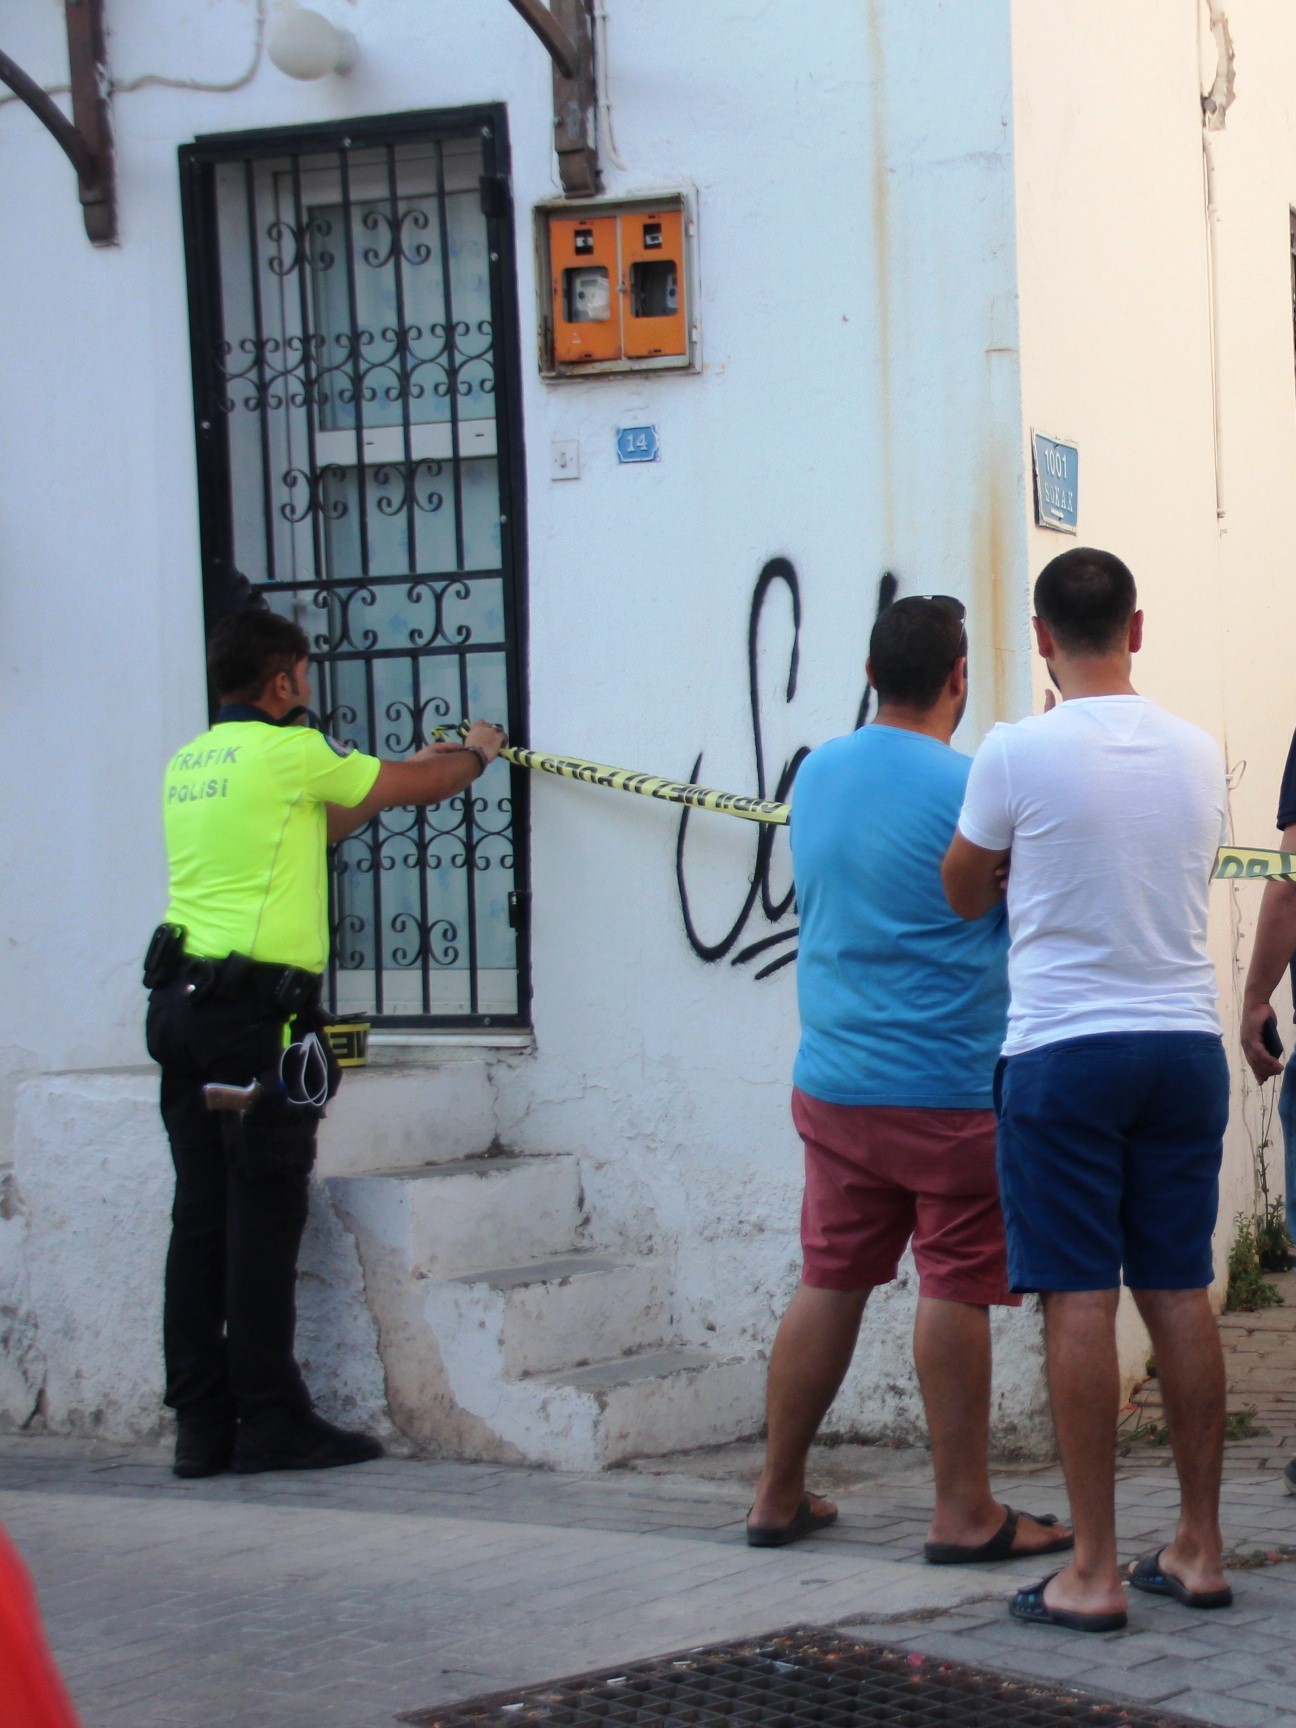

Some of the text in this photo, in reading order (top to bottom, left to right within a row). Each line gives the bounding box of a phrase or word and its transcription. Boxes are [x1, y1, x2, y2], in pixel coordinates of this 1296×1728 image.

[626, 433, 649, 452] 14
[1044, 447, 1067, 479] 1001
[1044, 482, 1074, 513] SOKAK
